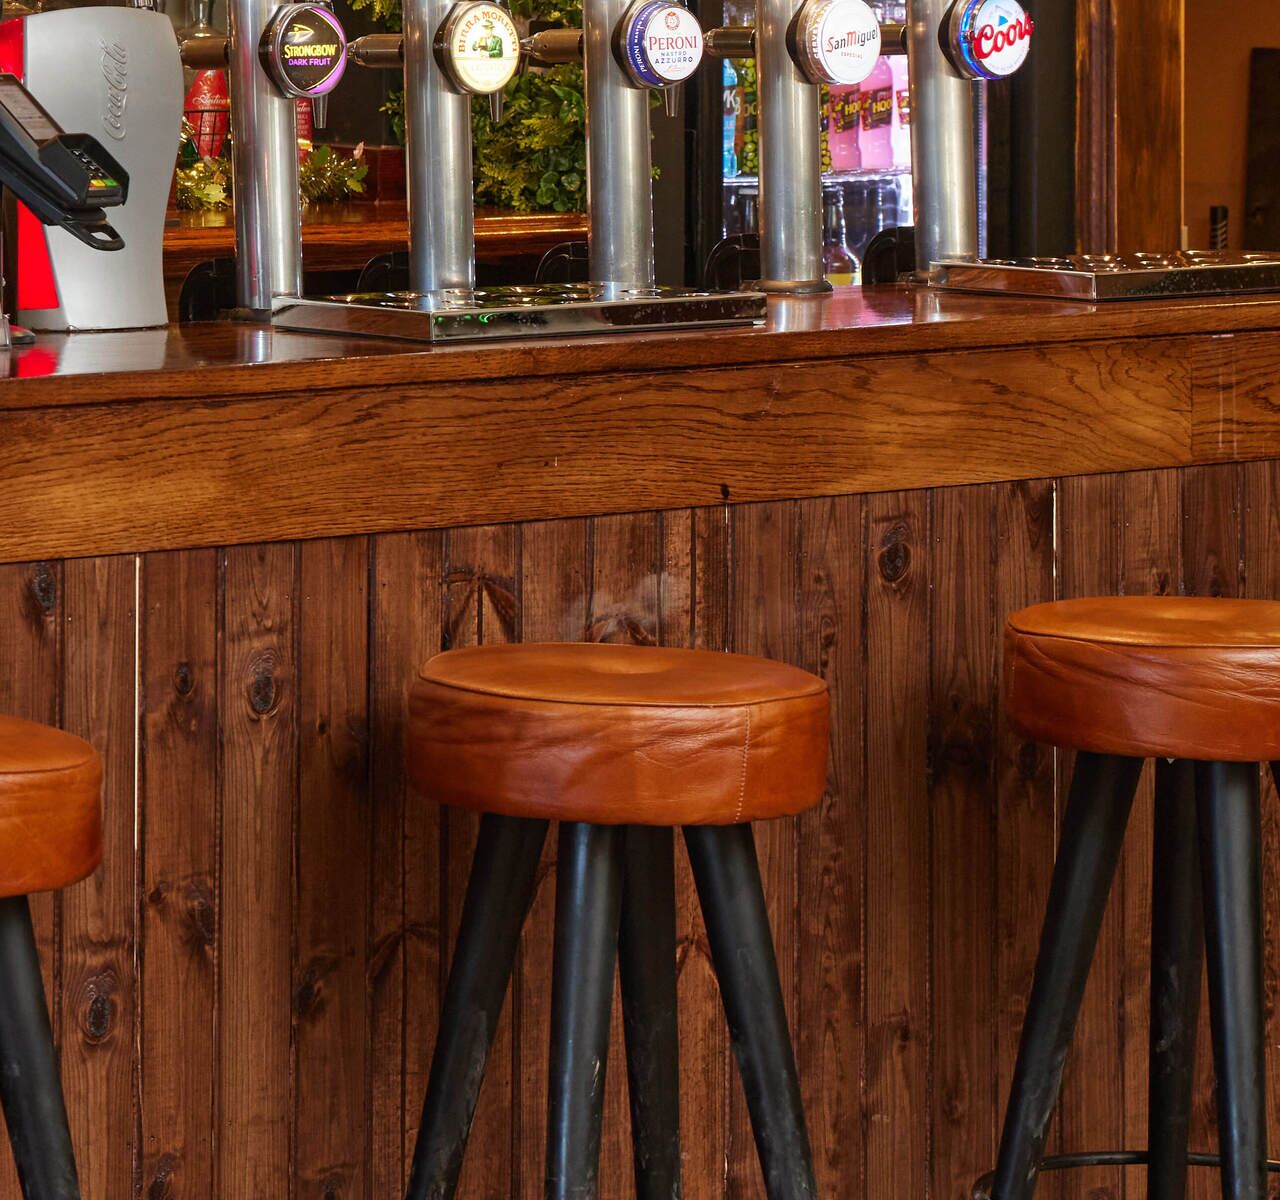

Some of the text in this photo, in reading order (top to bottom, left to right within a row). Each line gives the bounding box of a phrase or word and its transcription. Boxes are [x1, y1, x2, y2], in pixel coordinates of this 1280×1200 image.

[458, 15, 481, 53] BIRRA
[481, 10, 518, 53] MORETTI
[970, 11, 1035, 60] Coors
[648, 35, 697, 51] PERONI
[284, 44, 336, 59] STRONGBOW
[660, 50, 687, 58] NASTRO
[288, 57, 331, 66] DARK FRUIT
[654, 56, 694, 65] AZZURRO
